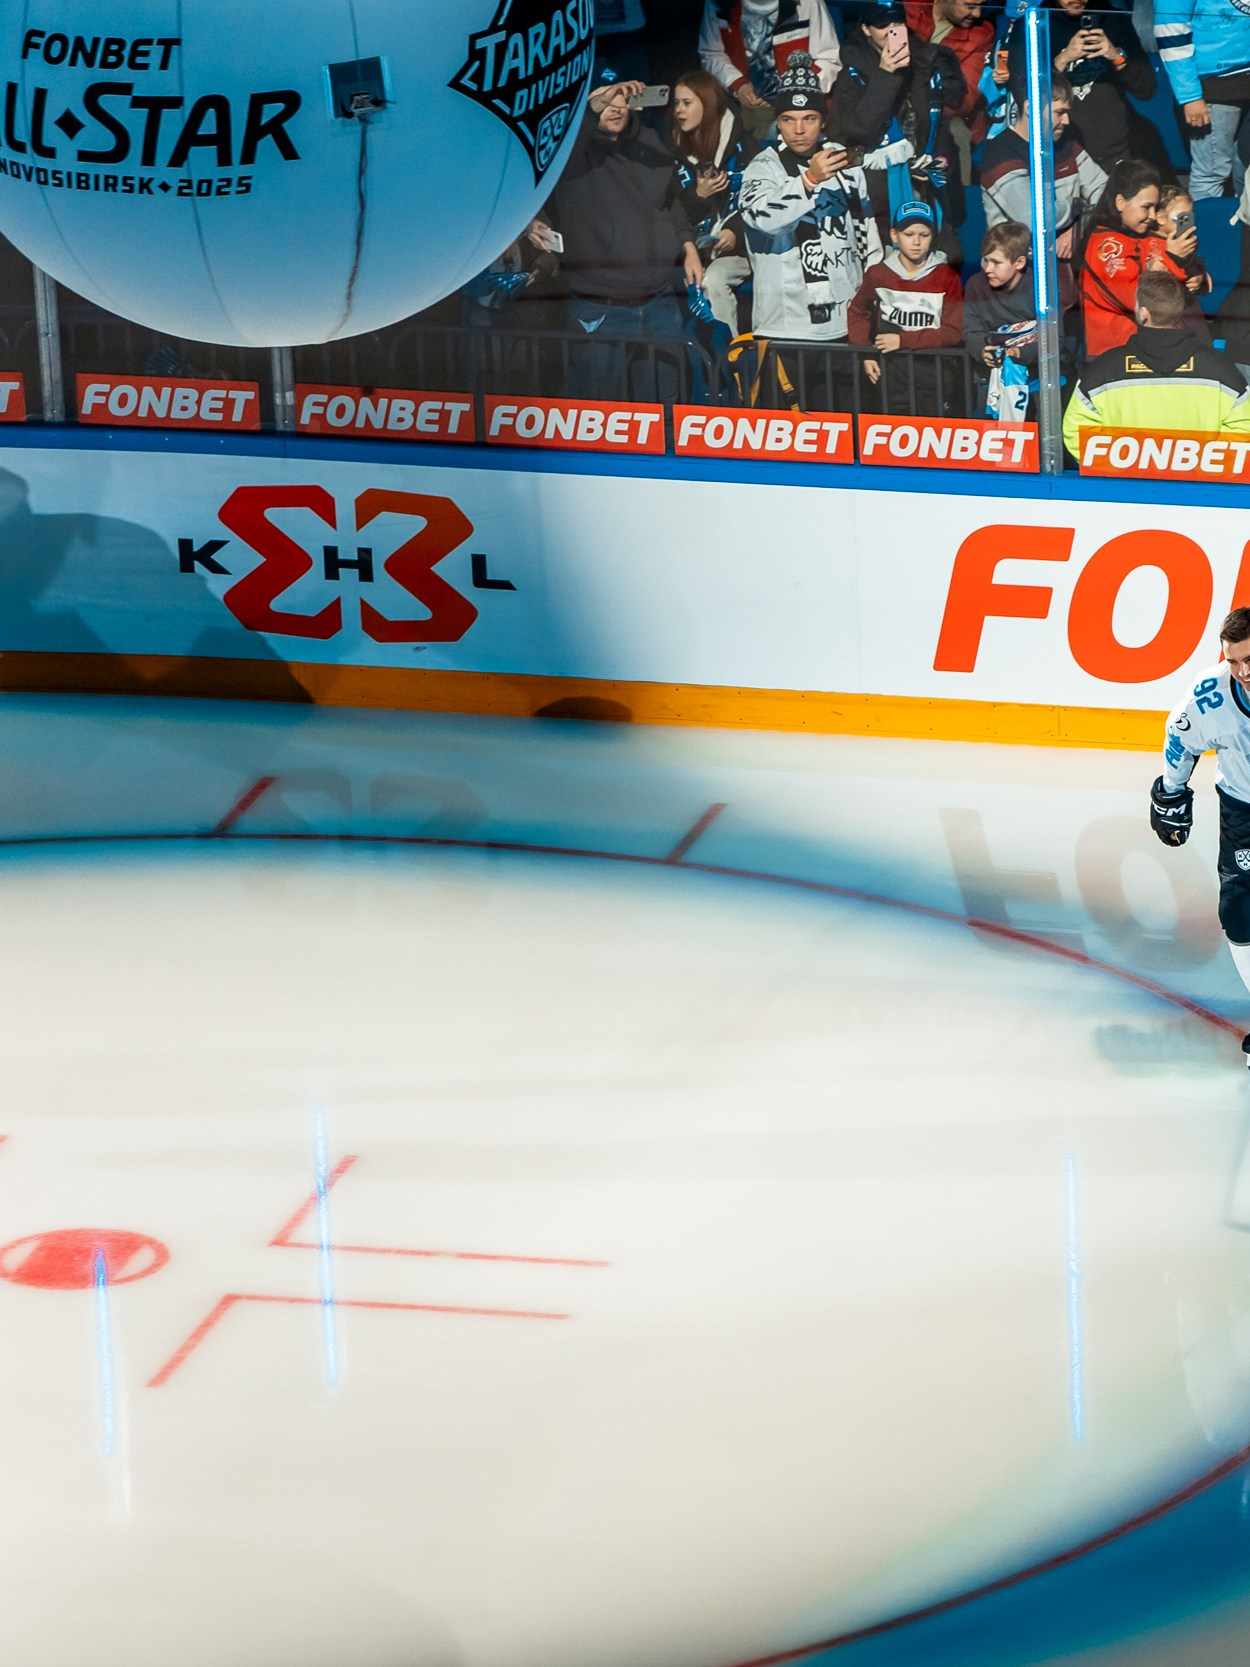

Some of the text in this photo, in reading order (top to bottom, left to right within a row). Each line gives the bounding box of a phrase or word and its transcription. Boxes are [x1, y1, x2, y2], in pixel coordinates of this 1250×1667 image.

[22, 28, 182, 71] FONBET
[176, 175, 253, 198] 2025
[888, 306, 936, 327] PUMA
[81, 383, 256, 422] FONBET
[300, 394, 471, 435] FONBET
[488, 404, 661, 445] FONBET
[677, 414, 849, 454] FONBET
[862, 424, 1035, 464] FONBET
